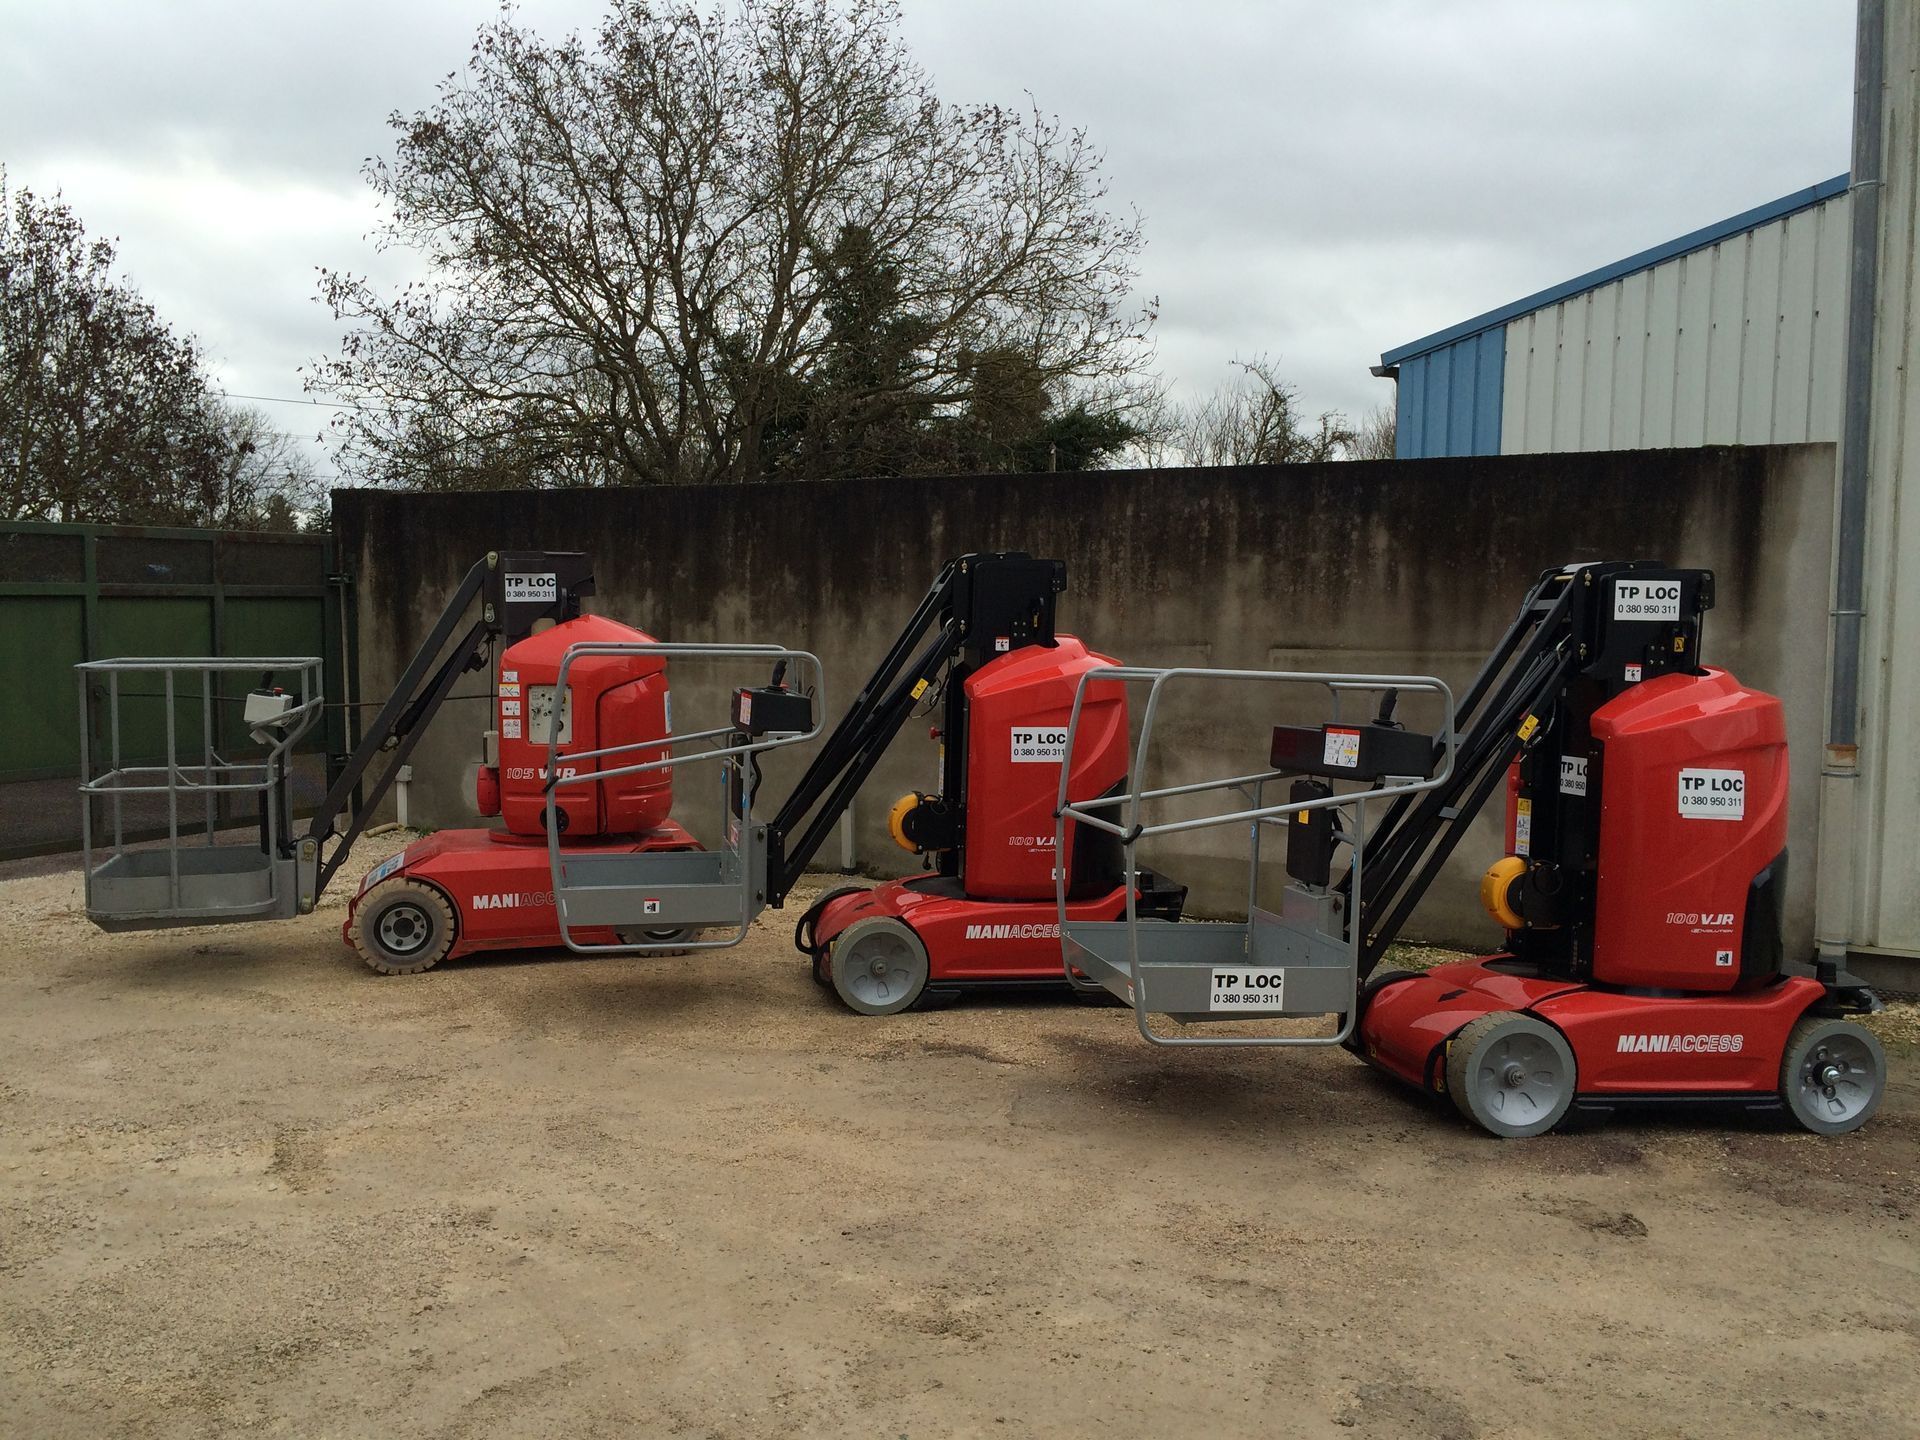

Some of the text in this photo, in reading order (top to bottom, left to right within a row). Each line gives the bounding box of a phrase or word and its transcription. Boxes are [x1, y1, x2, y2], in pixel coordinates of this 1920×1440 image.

[506, 578, 555, 587] TP LOC
[1618, 586, 1679, 600] TP LOC
[1618, 604, 1677, 615] 0 380 950 311
[1013, 733, 1066, 744] TP LOC
[1013, 748, 1065, 756] 0 380 950 311
[506, 767, 535, 780] 105
[1560, 761, 1588, 777] TP LO
[1564, 778, 1574, 789] 380
[1575, 780, 1585, 790] 950
[1682, 777, 1743, 792] TP LOC
[1682, 796, 1742, 807] 0 380 950 311
[1008, 836, 1064, 846] 100 VJ
[472, 891, 558, 910] MANIACC
[1666, 912, 1735, 925] 100 VJR
[965, 924, 1061, 939] MANIACCES
[1214, 974, 1282, 988] TP LOC
[1213, 993, 1280, 1003] 0 380 950 311
[1616, 1034, 1744, 1053] MANIACCESS
